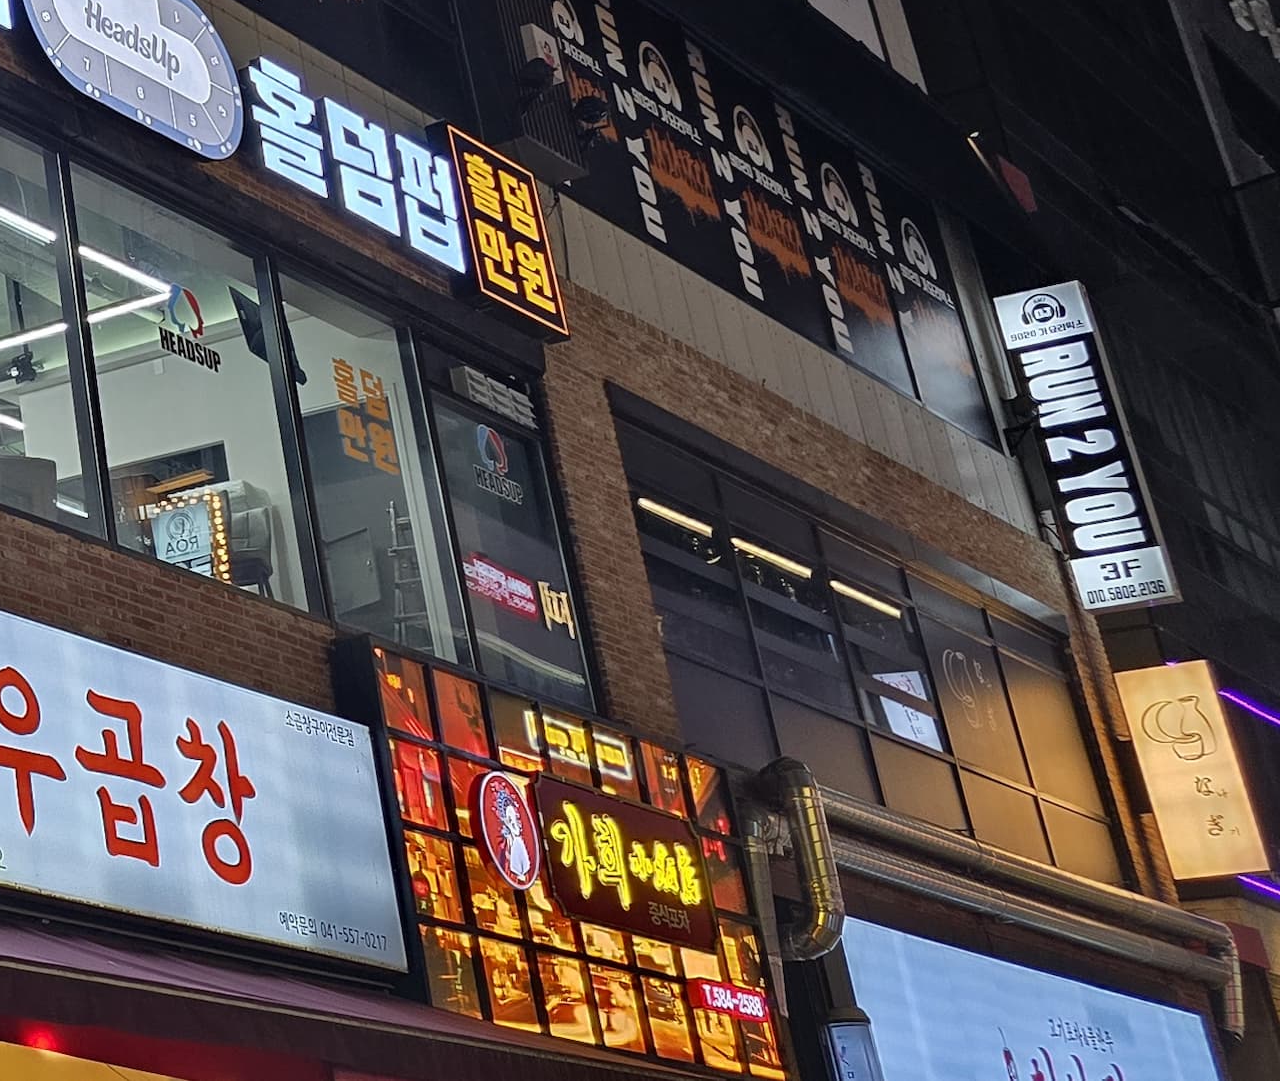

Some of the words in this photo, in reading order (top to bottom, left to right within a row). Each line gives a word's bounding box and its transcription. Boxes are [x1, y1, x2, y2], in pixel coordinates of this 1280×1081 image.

[612, 81, 637, 121] 2
[247, 54, 468, 275] 홀덤펍
[624, 135, 668, 245] YOU
[684, 38, 725, 143] RUN
[710, 146, 734, 184] 2
[723, 198, 765, 302] YOU
[463, 152, 540, 243] 홀덤
[774, 101, 813, 202] RUN
[800, 205, 824, 242] 2
[814, 256, 855, 355] YOU
[475, 222, 557, 315] 만원
[159, 325, 223, 376] HEADSUP
[1009, 325, 1038, 343] 9020
[1019, 339, 1108, 429] RUN
[1044, 428, 1117, 463] 2
[1056, 459, 1147, 552] YOU
[1086, 579, 1168, 605] 010.5802.2136
[1099, 558, 1143, 582] 3F
[283, 708, 358, 748] 소곱창구이전문점
[278, 910, 318, 939] 예약문의
[319, 919, 390, 954] 041-557-0217
[700, 982, 765, 1018] T.584-2588
